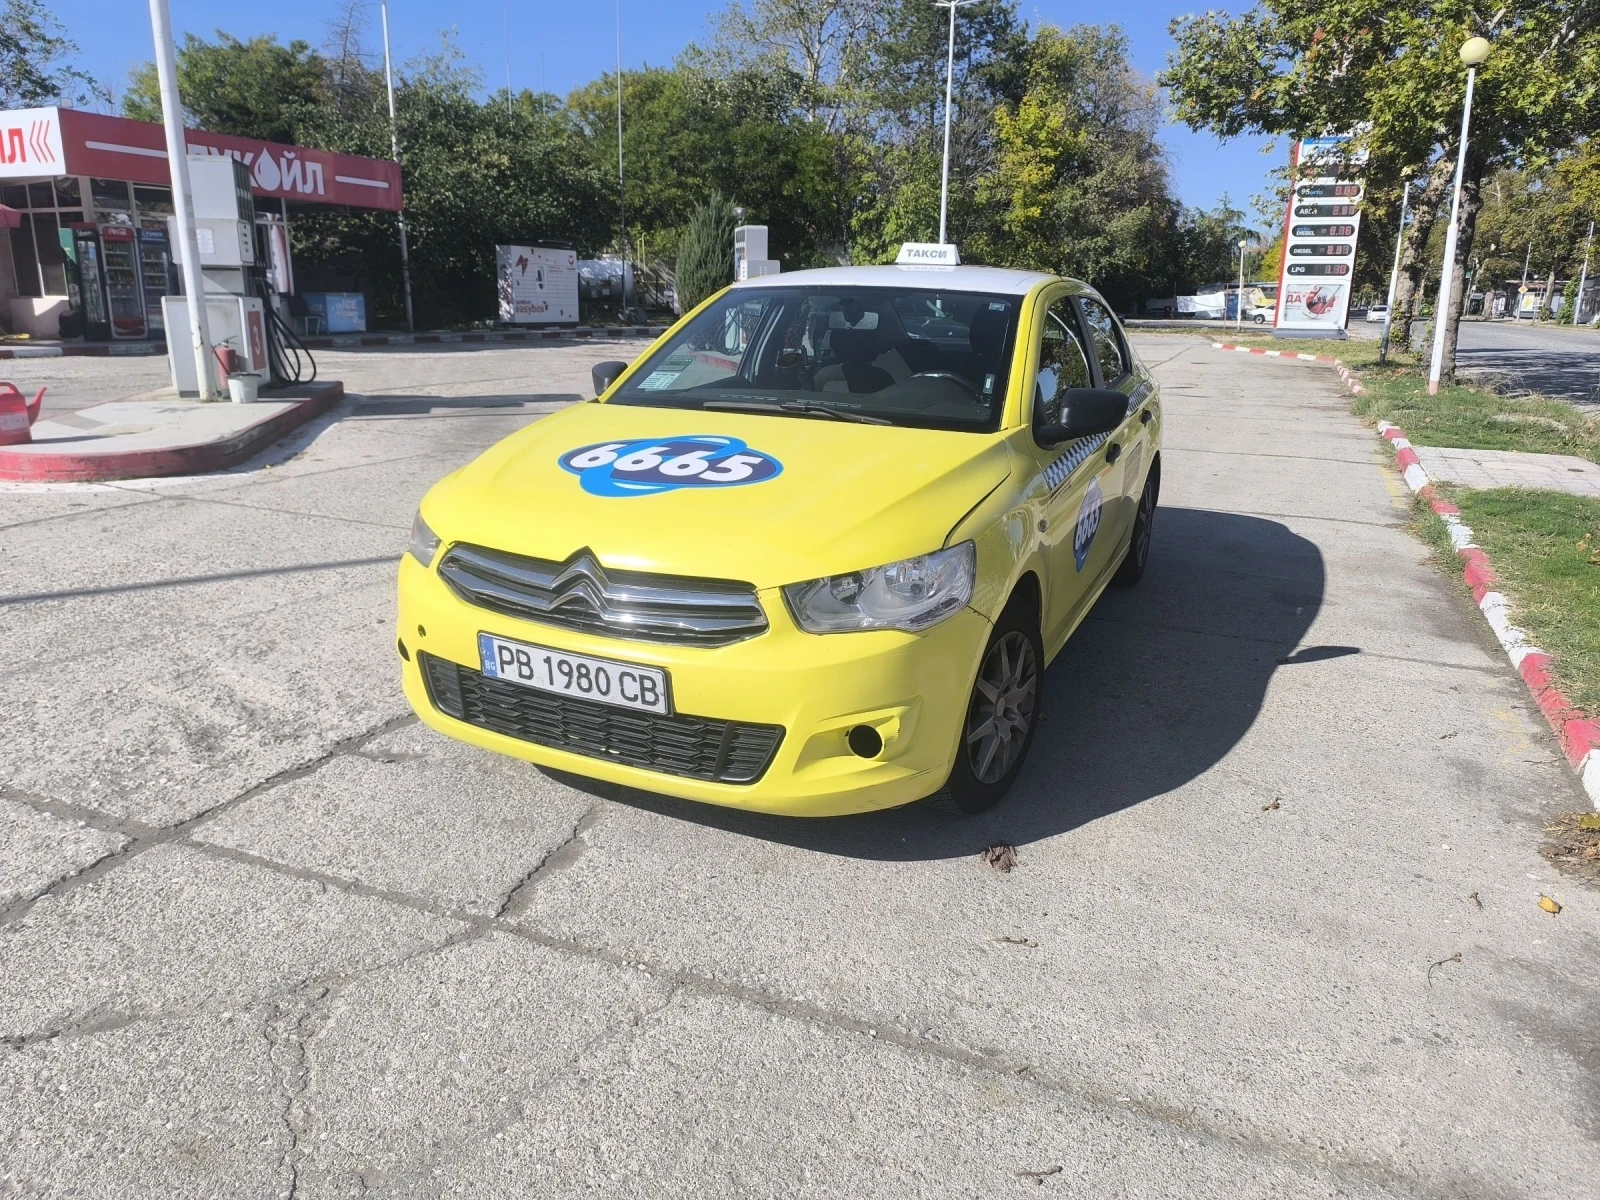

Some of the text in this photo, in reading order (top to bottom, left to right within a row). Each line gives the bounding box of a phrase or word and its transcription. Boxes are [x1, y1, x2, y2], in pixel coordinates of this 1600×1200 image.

[906, 249, 948, 259] ТАКСИ
[515, 303, 545, 315] easybox
[253, 325, 261, 356] 3
[570, 443, 764, 482] 6665
[484, 660, 496, 671] BG
[497, 644, 660, 706] PB 1980 CB
